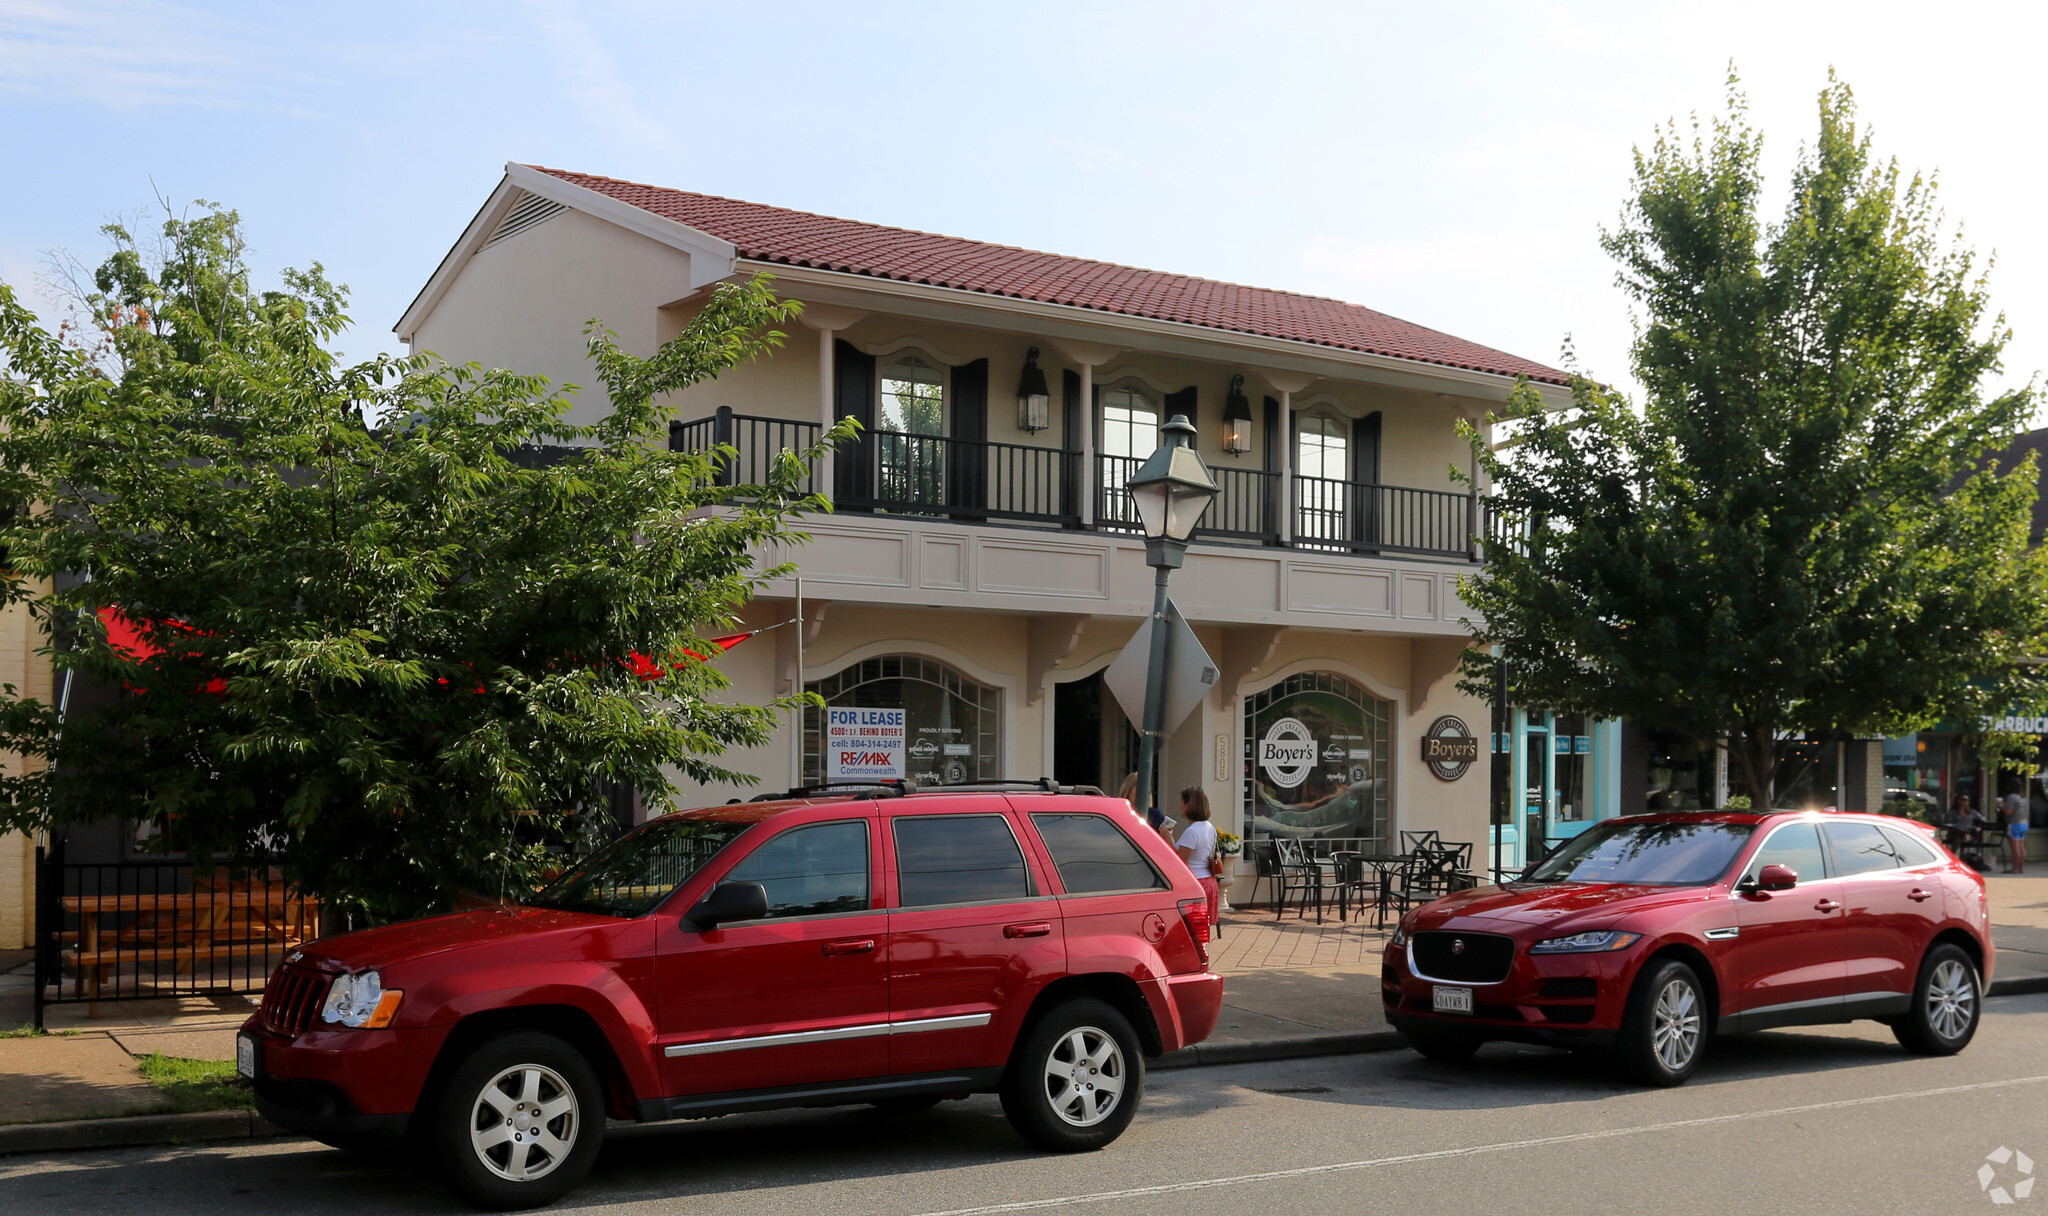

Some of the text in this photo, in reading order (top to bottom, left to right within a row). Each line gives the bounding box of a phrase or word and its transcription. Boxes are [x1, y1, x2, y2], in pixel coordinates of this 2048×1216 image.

[831, 711, 903, 725] FOR LEASE
[1274, 723, 1302, 736] ICE CREAM
[1438, 720, 1463, 731] ICE CREAM
[860, 728, 879, 736] BEHIND
[881, 728, 903, 736] BOYER'S
[831, 740, 901, 748] cell: 804-314-2497
[1428, 739, 1476, 760] Boyer's
[841, 751, 892, 765] RE/MAX
[1264, 743, 1313, 764] Boyer's
[840, 766, 896, 775] Commonwealth
[1441, 768, 1459, 777] COFFEE
[1279, 773, 1298, 782] COFFEE
